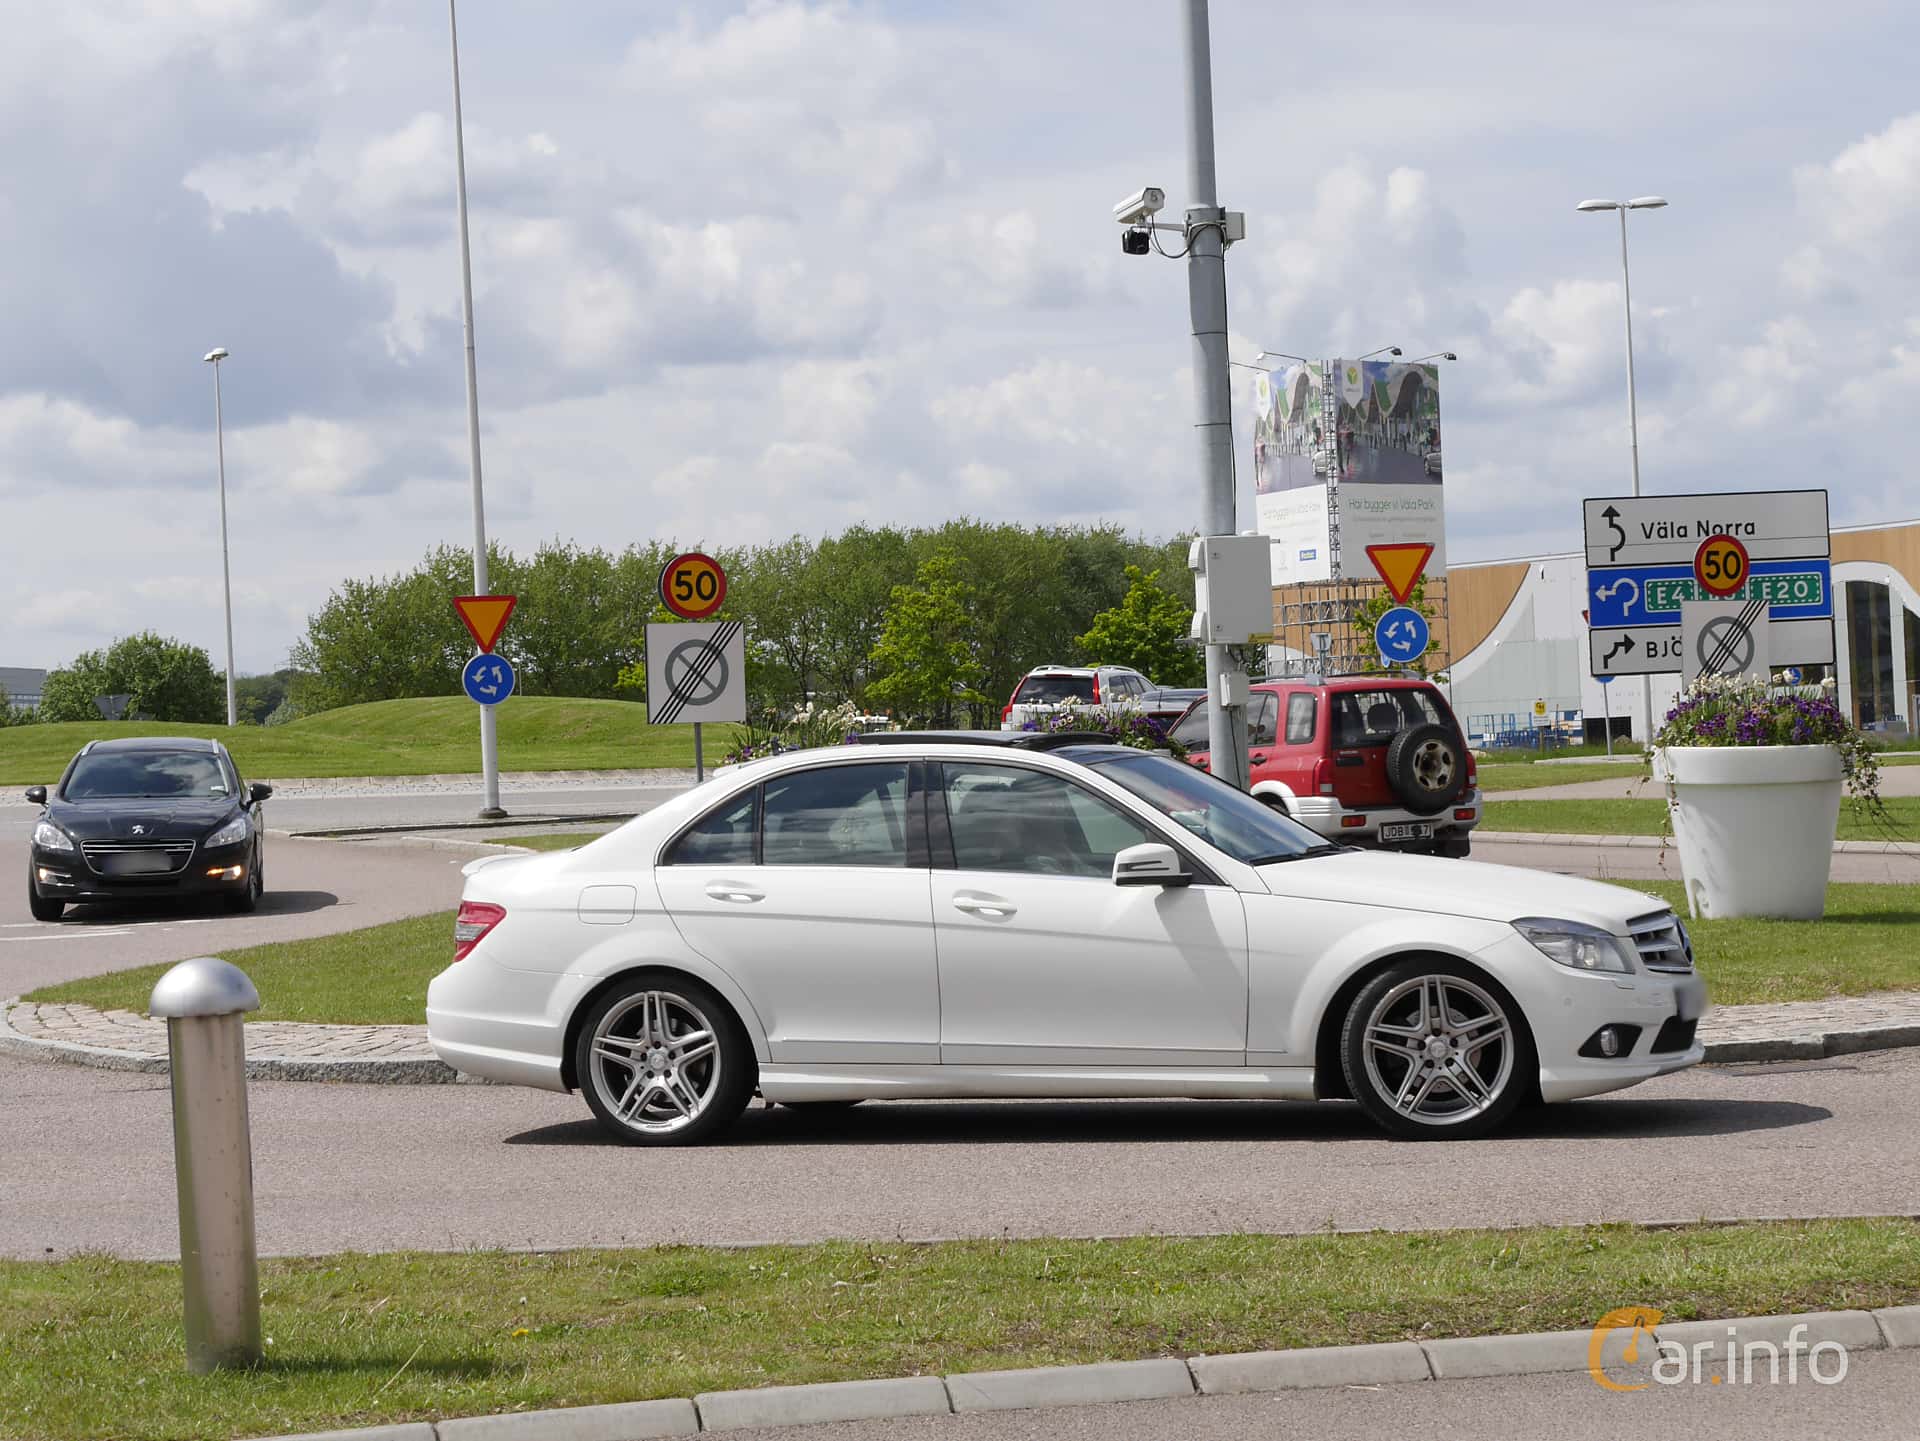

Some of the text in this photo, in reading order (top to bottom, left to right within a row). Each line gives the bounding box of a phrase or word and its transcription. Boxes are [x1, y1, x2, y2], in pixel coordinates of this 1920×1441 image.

[1641, 520, 1755, 539] Väla Norra
[1705, 550, 1741, 580] 50
[675, 570, 717, 601] 50
[1762, 580, 1808, 599] E20
[1657, 586, 1685, 605] E4
